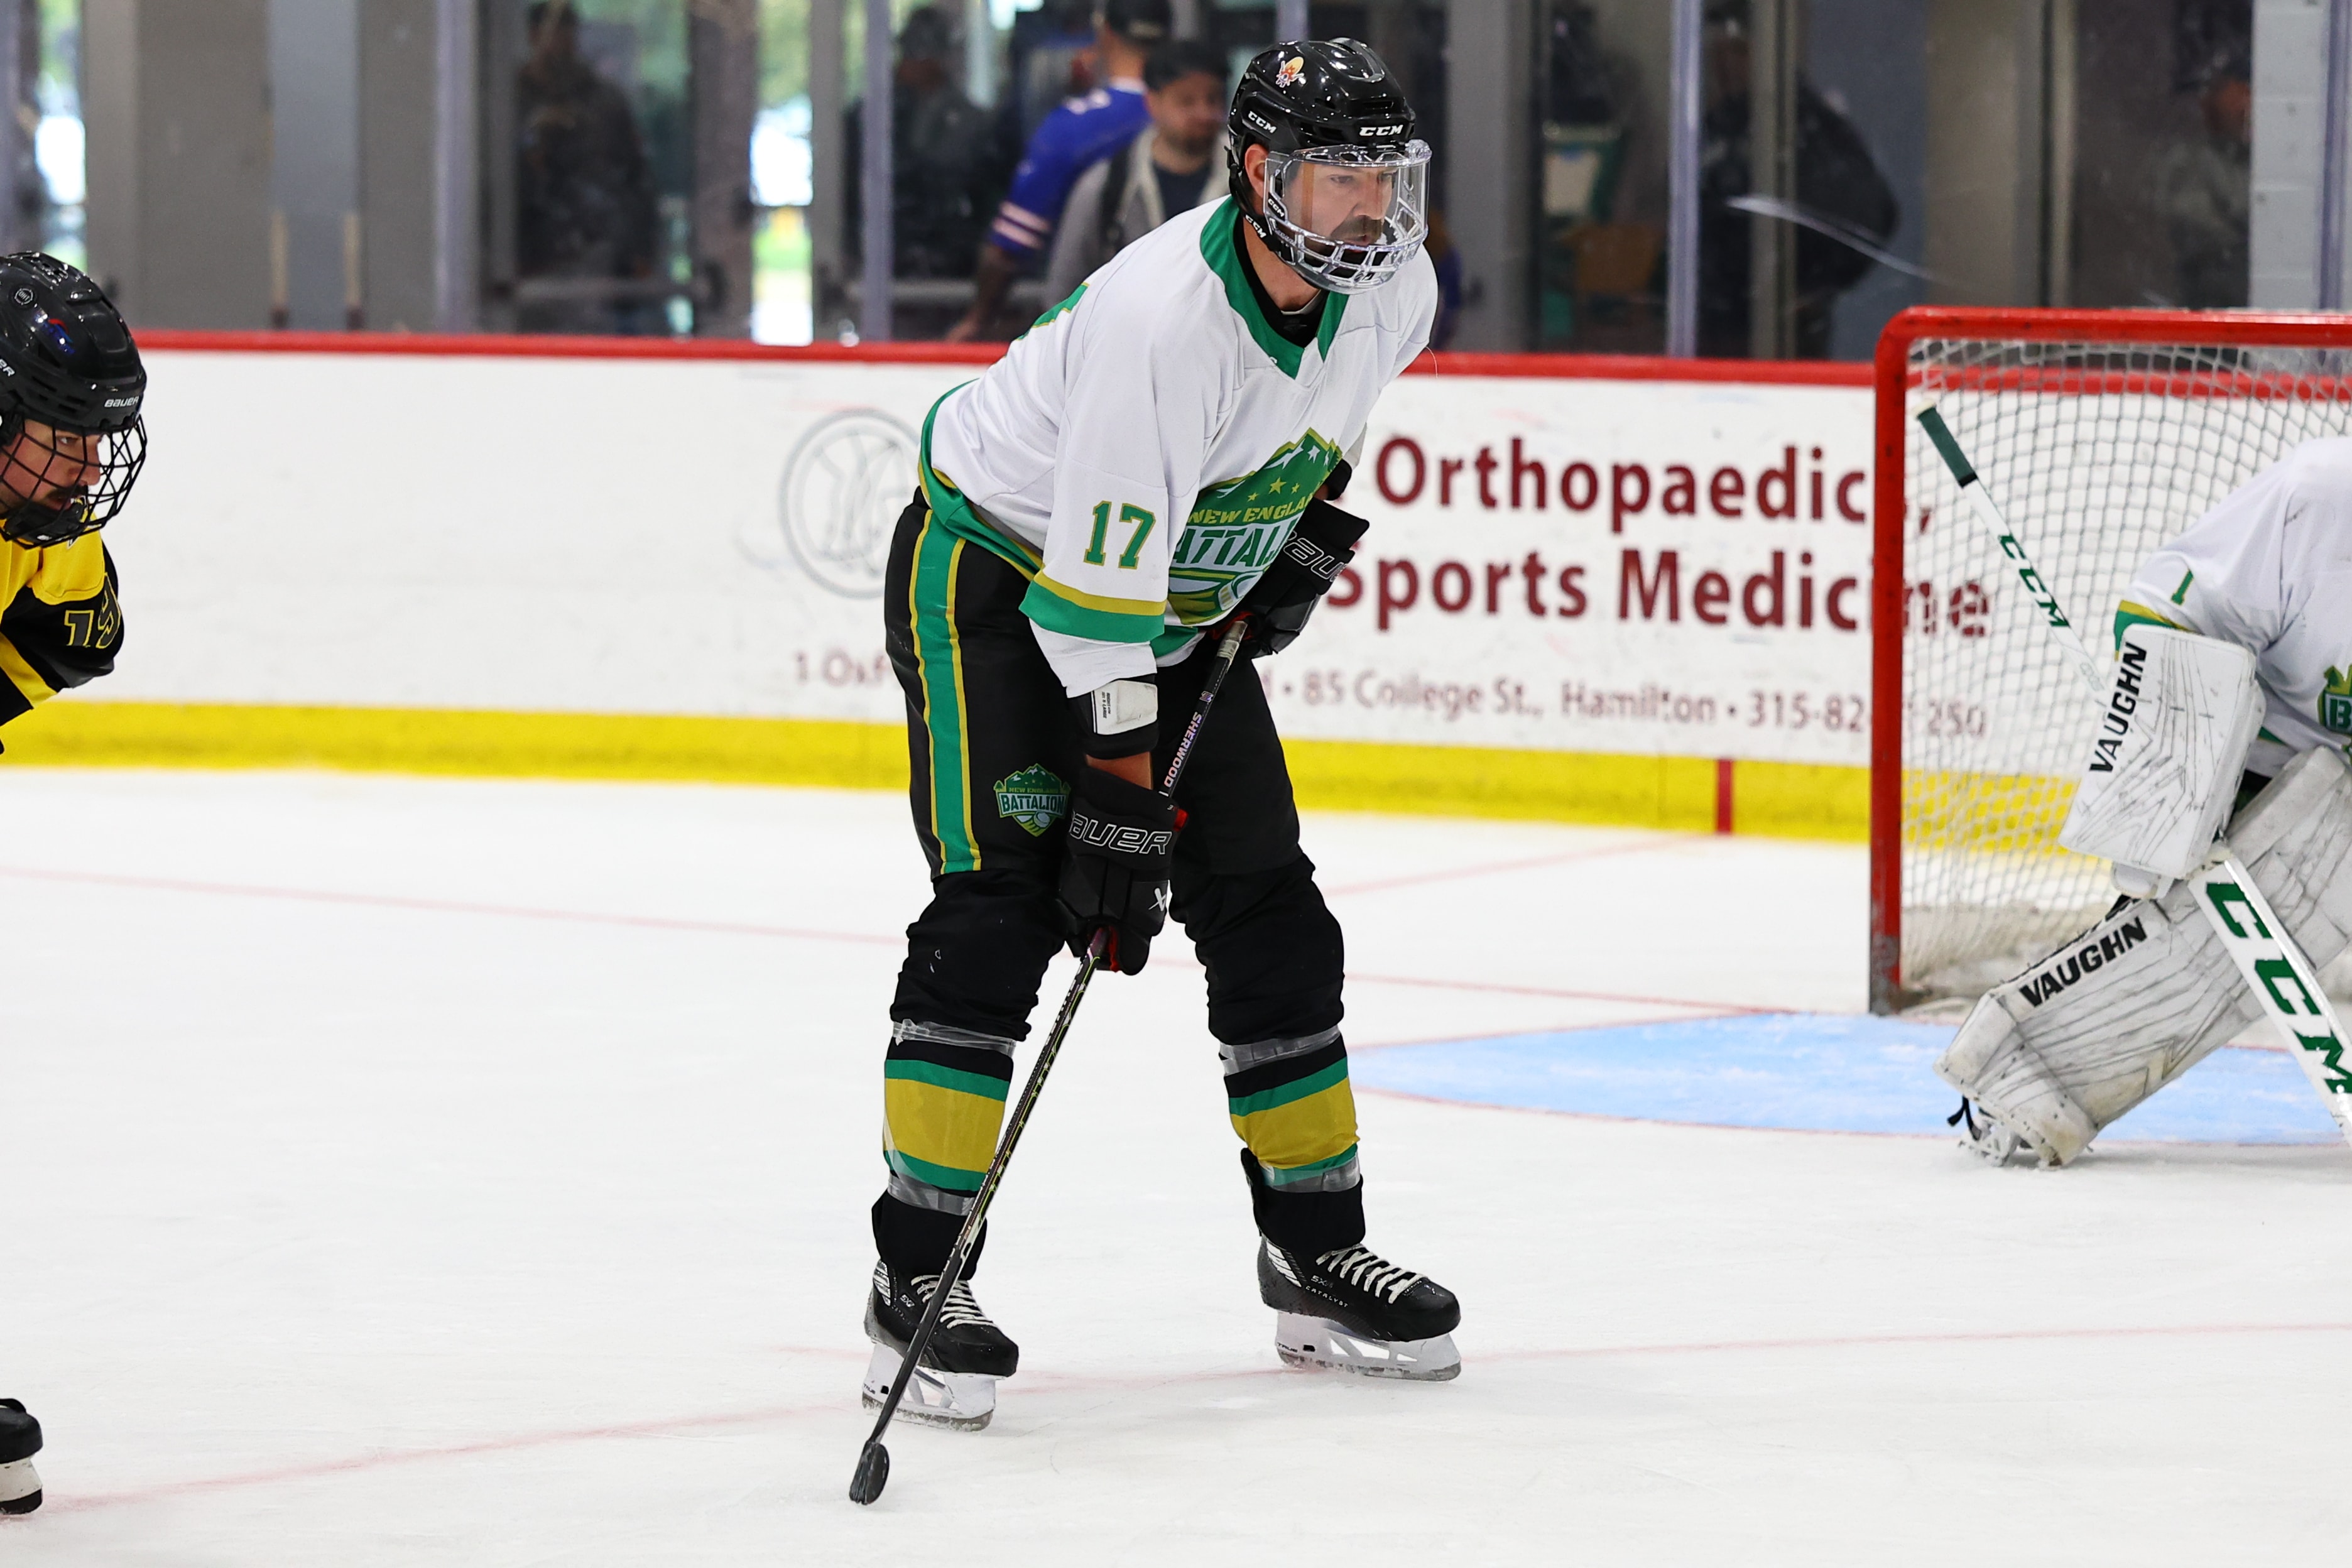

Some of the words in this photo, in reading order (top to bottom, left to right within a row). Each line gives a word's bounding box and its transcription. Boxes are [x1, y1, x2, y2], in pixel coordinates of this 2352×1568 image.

[1248, 111, 1277, 133] CCM
[1359, 124, 1403, 136] CCM
[1245, 214, 1267, 238] CCM
[1268, 199, 1285, 217] CCM
[104, 396, 139, 408] BAUER
[1376, 436, 1933, 535] Orthopaedic,
[1189, 509, 1242, 524] NEW
[1242, 493, 1314, 522] ENGLA
[1083, 500, 1157, 570] 17
[1618, 548, 1990, 637] Medicne
[1999, 534, 2071, 628] CCM
[1304, 669, 1346, 706] 85
[1561, 680, 1717, 724] Hamilton
[2089, 641, 2147, 773] VAUGHN
[1164, 711, 1202, 788] SHERWOOD
[1000, 794, 1065, 815] BATTALION
[1070, 813, 1172, 855] AUER
[2019, 916, 2147, 1008] VAUGHN
[2206, 881, 2352, 1094] CCM
[1305, 1285, 1348, 1308] CATALYST
[1277, 1342, 1298, 1353] TRUE
